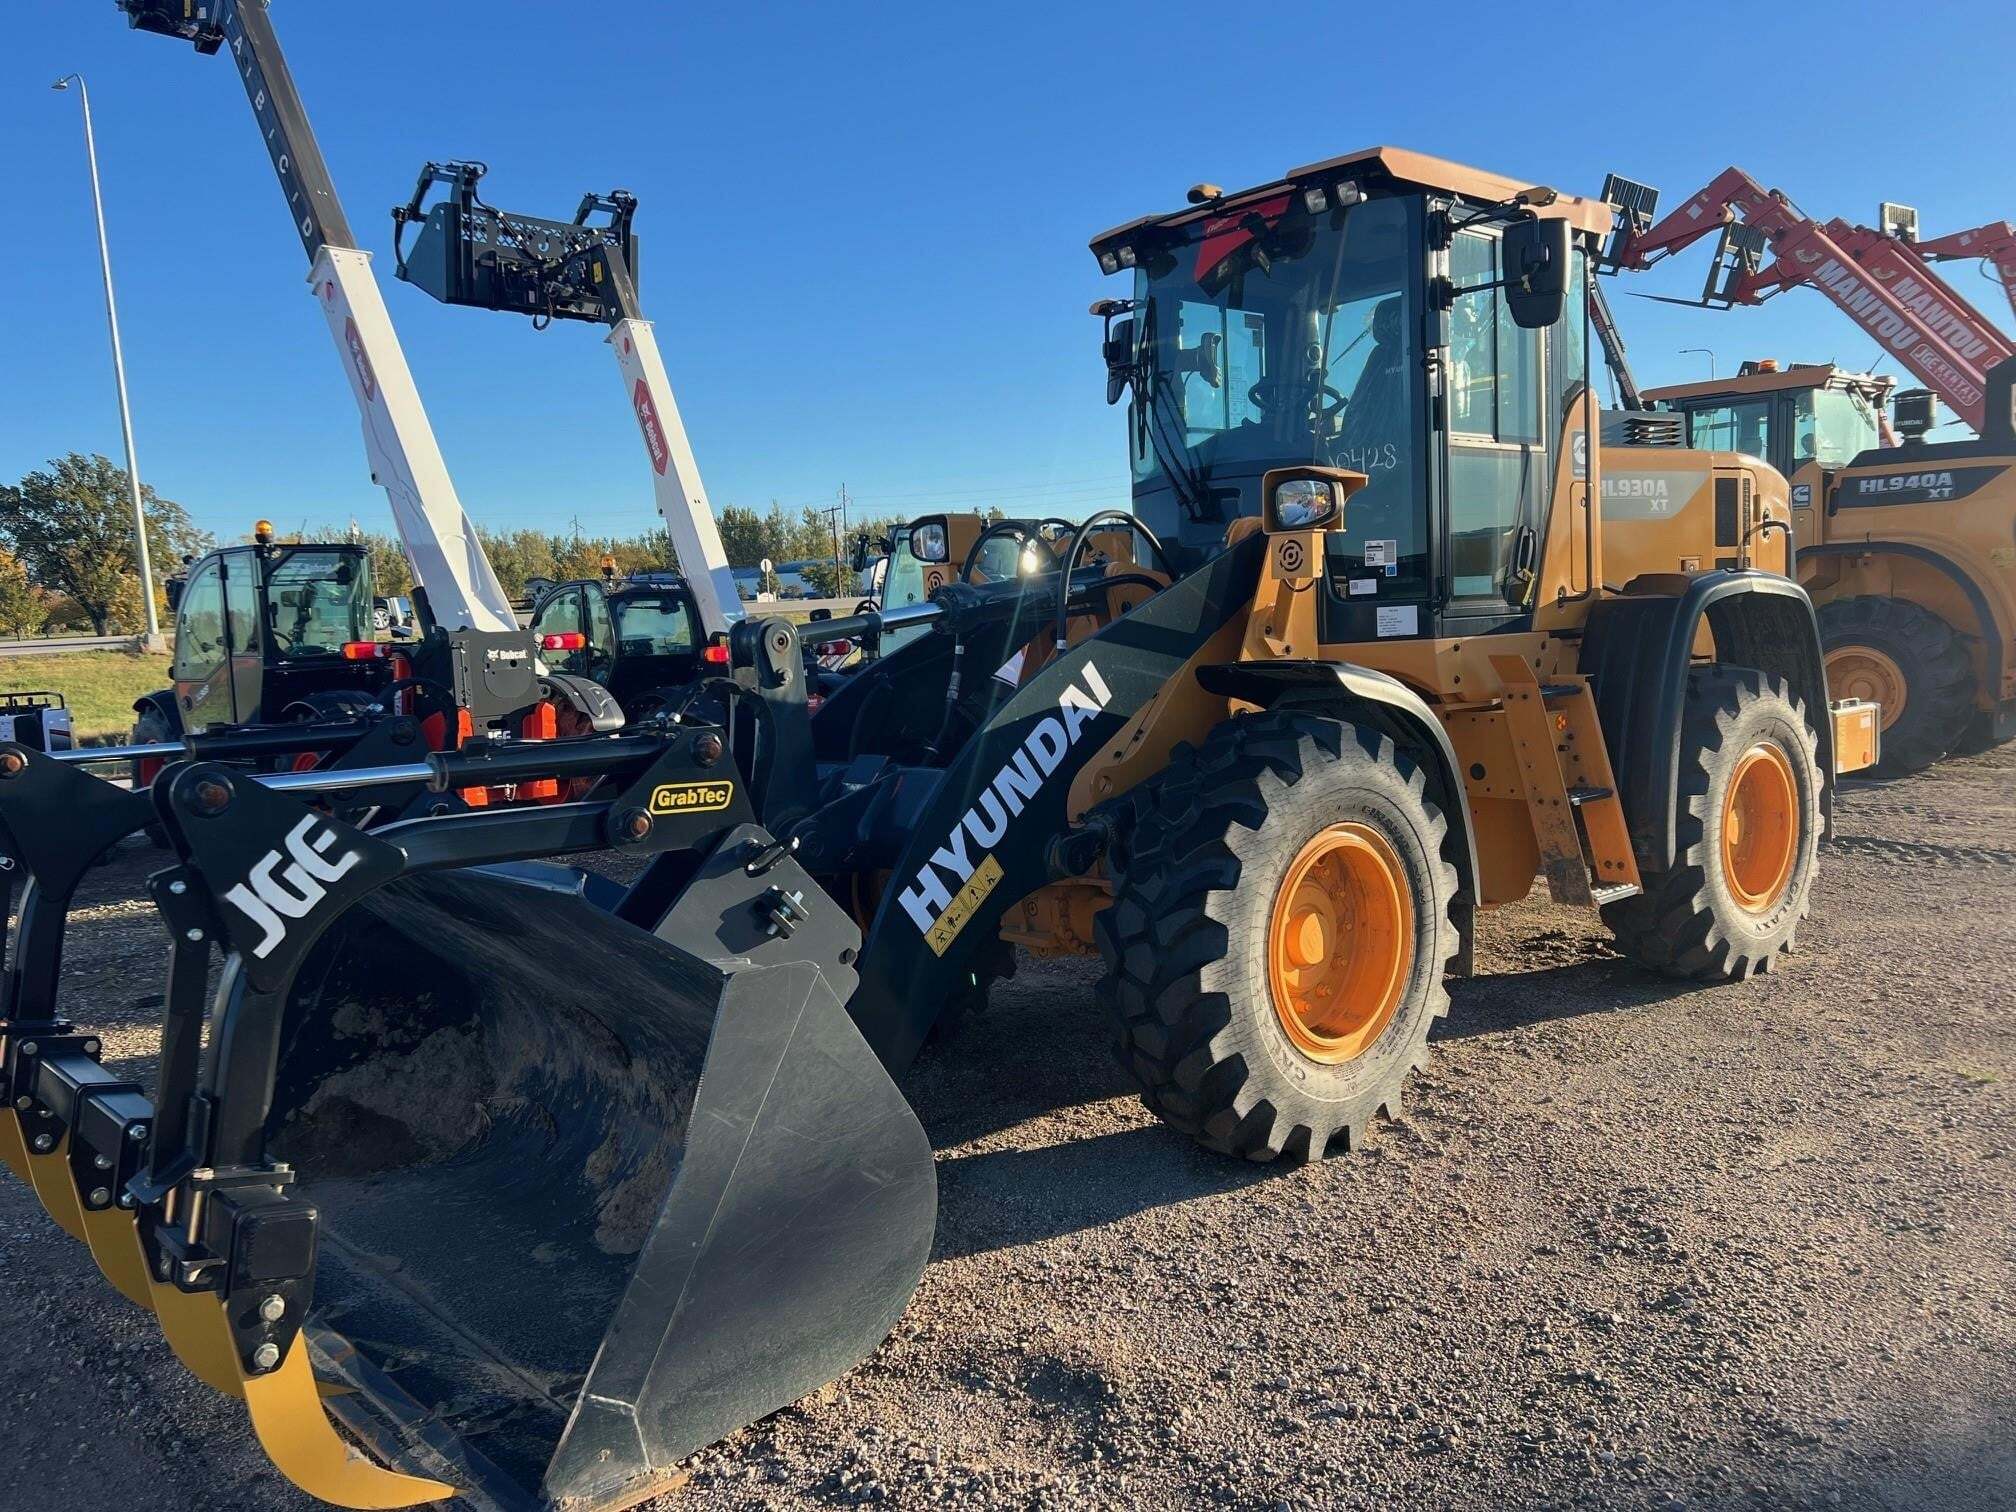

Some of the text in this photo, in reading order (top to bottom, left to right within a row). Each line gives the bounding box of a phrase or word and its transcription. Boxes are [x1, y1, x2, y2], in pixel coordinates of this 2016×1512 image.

[1813, 258, 1920, 350] MANITOU
[1890, 276, 1988, 359] MANITOU
[1914, 345, 1940, 370] JGE
[645, 420, 663, 462] Bobcat
[1859, 472, 1953, 494] HL940A
[1928, 487, 1953, 499] XT
[1651, 498, 1669, 513] XT
[500, 649, 528, 660] Bobcat
[657, 787, 726, 806] GrabTec
[898, 660, 1112, 934] HYUNDAI
[224, 813, 361, 959] JGE
